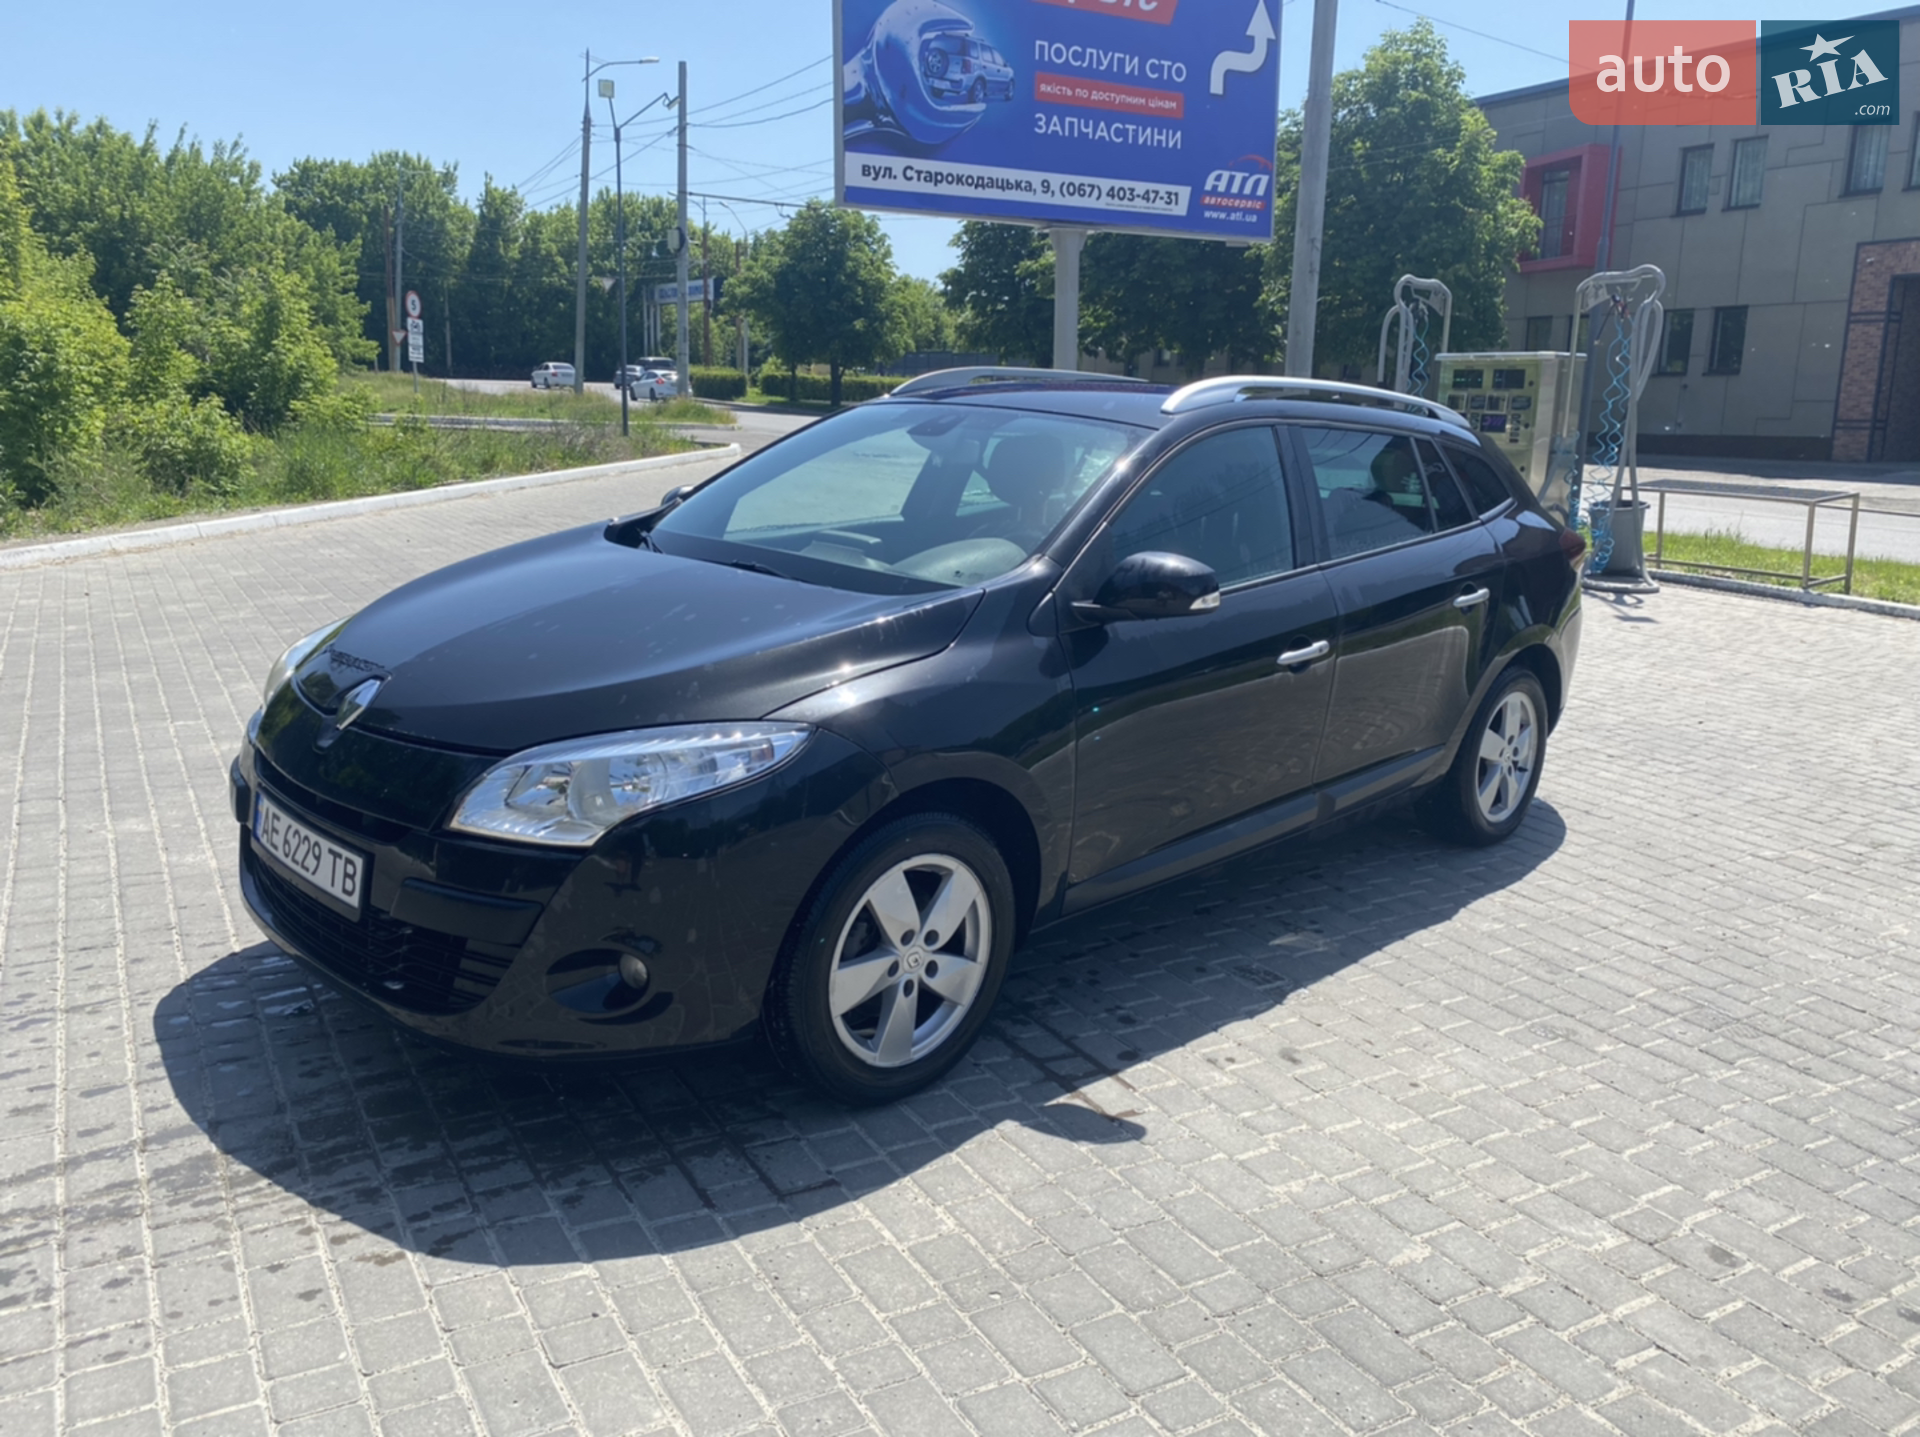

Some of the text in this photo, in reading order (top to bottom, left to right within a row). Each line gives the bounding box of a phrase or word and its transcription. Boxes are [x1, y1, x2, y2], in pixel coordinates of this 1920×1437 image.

[1034, 39, 1188, 83] ПОСЛУГИ СТО
[1039, 82, 1073, 97] якість
[1075, 88, 1089, 98] по
[1034, 112, 1182, 150] ЗАПЧАСТИНИ
[861, 163, 1179, 206] вул. Старокодацька, 9, (067) 403-47-31
[1203, 210, 1258, 223] www.atl.ua
[411, 299, 417, 311] 5
[261, 806, 357, 898] AE 6229 TB
